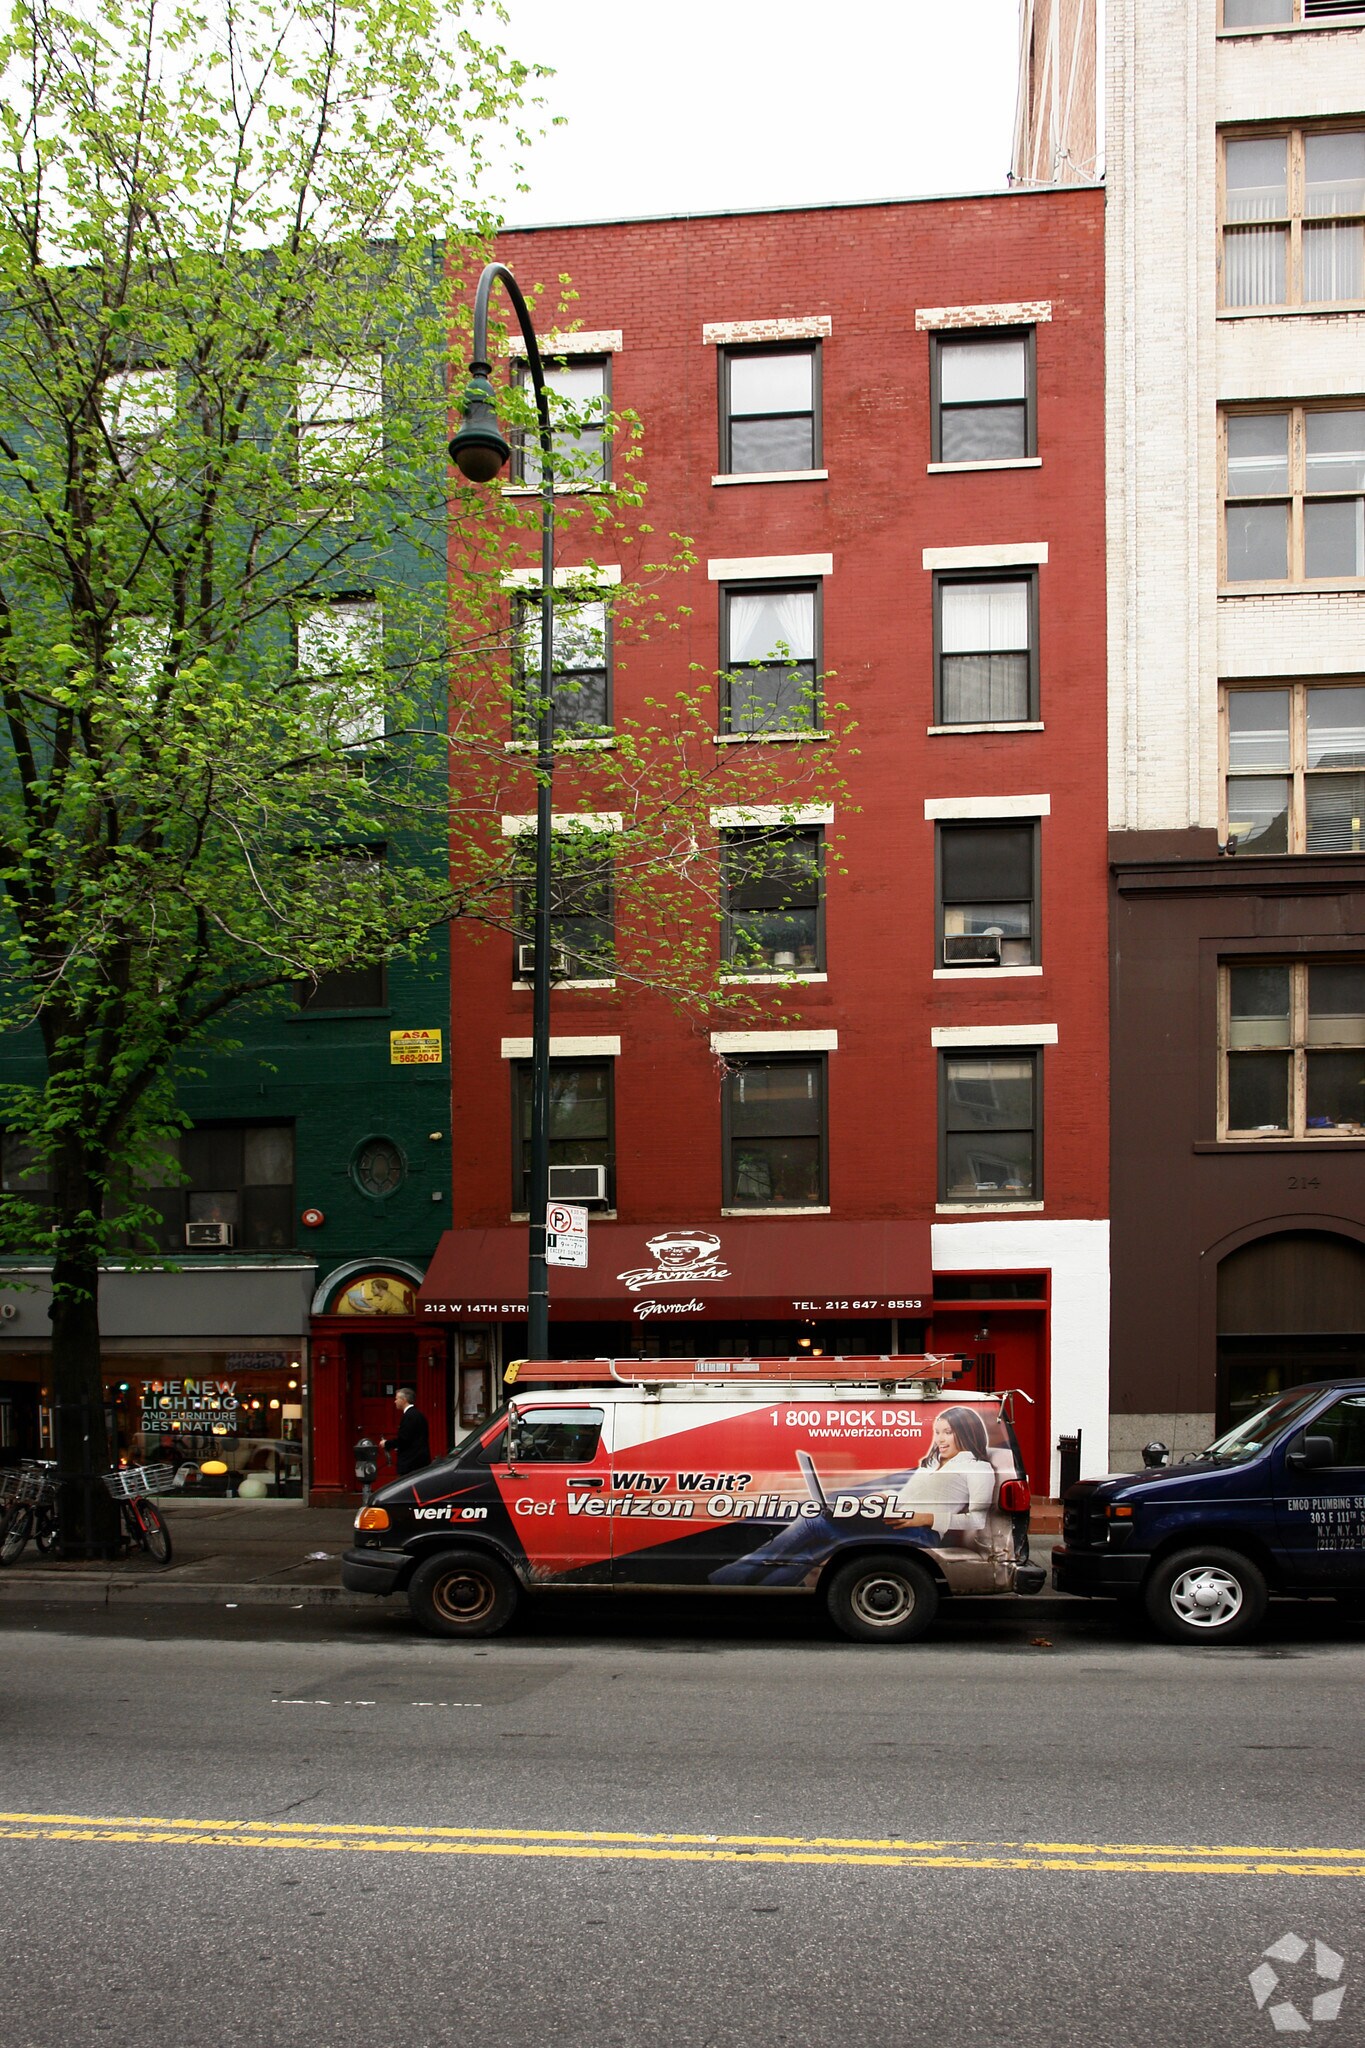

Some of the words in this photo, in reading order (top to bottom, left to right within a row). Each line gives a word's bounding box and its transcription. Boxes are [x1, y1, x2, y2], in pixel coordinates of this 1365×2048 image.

[399, 1053, 440, 1063] 562-2047
[1287, 1176, 1321, 1190] 214
[617, 1266, 732, 1287] Gavroche
[424, 1304, 447, 1312] 212
[450, 1304, 462, 1312] W
[467, 1304, 498, 1312] 14TH
[633, 1298, 706, 1320] Gavroche
[792, 1302, 822, 1310] TEL.
[825, 1301, 849, 1309] 212
[852, 1301, 877, 1309] 647
[887, 1300, 922, 1308] 8553
[141, 1381, 181, 1395] THE
[185, 1381, 237, 1395] NEW
[141, 1396, 237, 1410] LIGHTING
[142, 1411, 167, 1420] AND
[170, 1411, 237, 1420] FURNITURE
[770, 1410, 778, 1426] 1
[785, 1410, 821, 1426] 800
[826, 1410, 876, 1426] PICK
[881, 1410, 923, 1426] DSL
[141, 1421, 237, 1431] DESTINATION
[808, 1426, 922, 1437] www.verizon.com
[612, 1472, 669, 1493] Why
[677, 1472, 752, 1491] Wait?
[515, 1497, 557, 1516] Get
[566, 1492, 695, 1517] Verizon
[706, 1494, 821, 1518] Online
[832, 1494, 914, 1520] DSL.
[1288, 1499, 1309, 1511] EMCO
[1312, 1498, 1351, 1510] PLUMBING
[413, 1504, 488, 1523] verizon
[1310, 1512, 1326, 1524] 303
[1328, 1512, 1334, 1523] E
[1337, 1525, 1353, 1537] N.Y.
